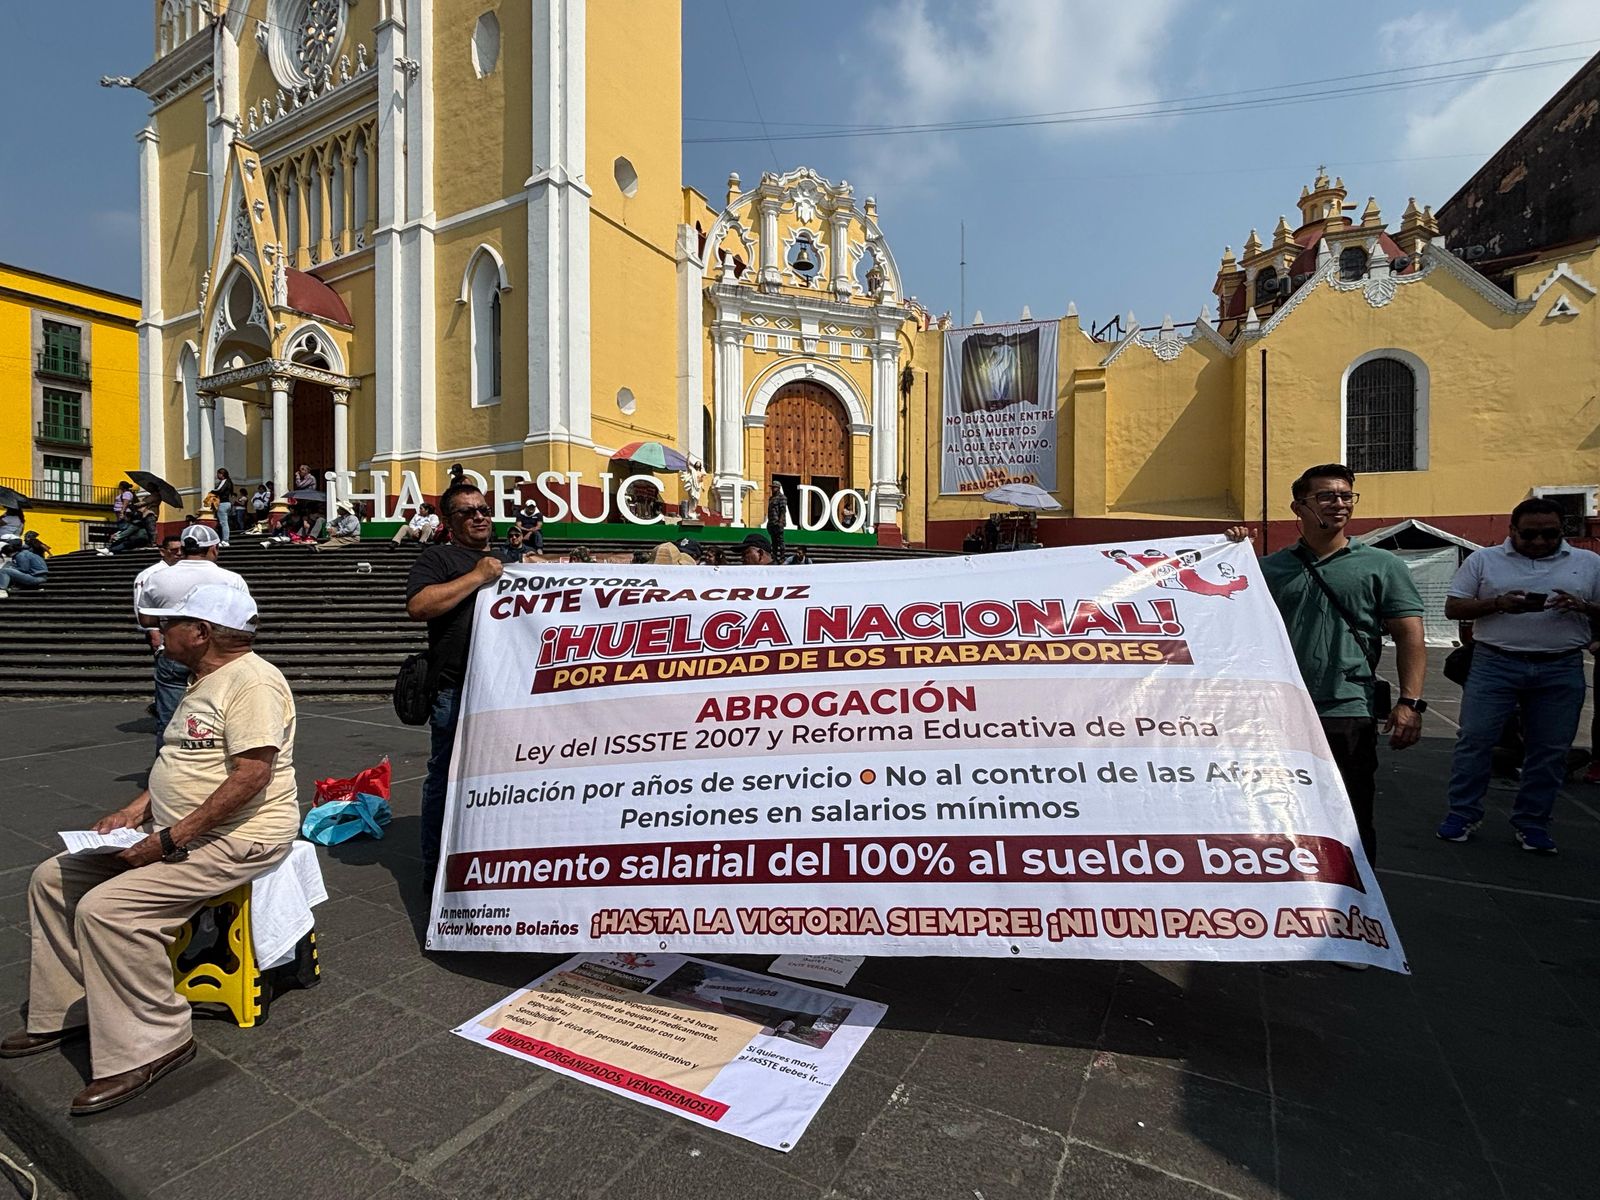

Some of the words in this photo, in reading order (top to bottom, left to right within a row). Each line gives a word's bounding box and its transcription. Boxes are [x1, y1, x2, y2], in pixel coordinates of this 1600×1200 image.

[946, 416, 961, 425] NO
[966, 413, 1016, 424] BUSQUEN
[1020, 410, 1054, 421] ENTRE
[962, 429, 981, 438] LOS
[985, 426, 1037, 437] MUERTOS
[947, 444, 960, 453] AL
[964, 443, 985, 452] QUE
[989, 438, 1016, 451] ESTÁ
[958, 457, 974, 466] NO
[978, 453, 1005, 465] ESTÁ
[1008, 451, 1040, 464] AQUÍ:
[489, 587, 581, 620] CNTE
[599, 584, 812, 609] VERACRUZ
[497, 575, 659, 595] PROMOTORA
[536, 606, 793, 669] ¡HUELGA
[803, 598, 1186, 644] NACIONAL!
[553, 667, 607, 689] POR
[614, 663, 649, 682] LA
[657, 655, 759, 679] UNIDAD
[778, 650, 818, 670] DE
[827, 647, 887, 668] LOS
[898, 642, 1164, 665] TRABAJADORES
[695, 680, 977, 723] ABROGACIÓN
[515, 742, 555, 765] Ley
[560, 737, 596, 759] del
[603, 730, 687, 755] ISSSTE
[695, 727, 761, 750] 2007
[765, 730, 784, 750] y
[791, 720, 913, 744] Reforma
[923, 716, 1077, 740] Educativa
[1085, 715, 1126, 738] de
[1134, 715, 1219, 738] Peña
[465, 781, 575, 808] Jubilación
[582, 780, 625, 803] por
[631, 775, 693, 797] años
[701, 771, 734, 793] de
[742, 766, 852, 791] servicio
[886, 766, 926, 787] No
[936, 762, 962, 786] al
[971, 761, 1087, 785] control
[1097, 760, 1139, 783] de
[1148, 761, 1196, 783] las
[1205, 760, 1313, 786] Afoes
[620, 804, 758, 829] Pensiones
[767, 804, 802, 823] en
[811, 798, 926, 822] salarios
[936, 795, 1079, 820] mínimos
[464, 852, 610, 885] Aumento
[619, 843, 755, 880] salarial
[768, 843, 830, 876] del
[843, 842, 956, 877] 100%
[968, 841, 1006, 875] al
[1021, 839, 1185, 876] sueldo
[1199, 839, 1320, 876] base
[437, 921, 464, 935] Víctor
[465, 922, 512, 936] Moreno
[515, 920, 579, 936] Bolaños
[440, 906, 449, 919] In
[450, 904, 511, 919] memoriam:
[590, 907, 688, 939] ¡HASTA
[694, 908, 734, 936] LA
[737, 906, 883, 935] VICTORIA
[887, 907, 1042, 938] SIEMPRE!
[1047, 908, 1099, 942] ¡NI
[1102, 908, 1159, 938] UN
[1163, 907, 1269, 939] PASO
[1273, 906, 1390, 949] ATRÁS!
[527, 1000, 572, 1017] especialista!
[565, 1001, 582, 1010] citas
[582, 1006, 593, 1014] de
[593, 1010, 618, 1021] meses
[617, 1018, 636, 1028] para
[635, 1023, 658, 1034] pasar
[658, 1030, 674, 1039] con
[674, 1035, 686, 1043] un
[581, 996, 614, 1010] completa
[614, 1004, 625, 1013] de
[625, 1010, 653, 1021] equipo
[658, 1020, 719, 1042] medicamentos.
[624, 1001, 671, 1017] especialistas
[671, 1013, 684, 1021] las
[684, 1017, 696, 1025] 24
[695, 1021, 719, 1032] horas
[516, 1006, 560, 1023] Sensibilidad
[564, 1022, 584, 1032] ética
[584, 1028, 598, 1036] del
[596, 1033, 633, 1048] personal
[631, 1043, 692, 1066] administrativo
[749, 1055, 779, 1070] ISSSTE
[779, 1066, 808, 1080] debes
[757, 1048, 790, 1064] quieres
[791, 1058, 819, 1073] morir,
[536, 1045, 547, 1055] Y
[544, 1049, 624, 1084] ORGANIZADOS,
[626, 1077, 719, 1116] VENCEREMOS!!
